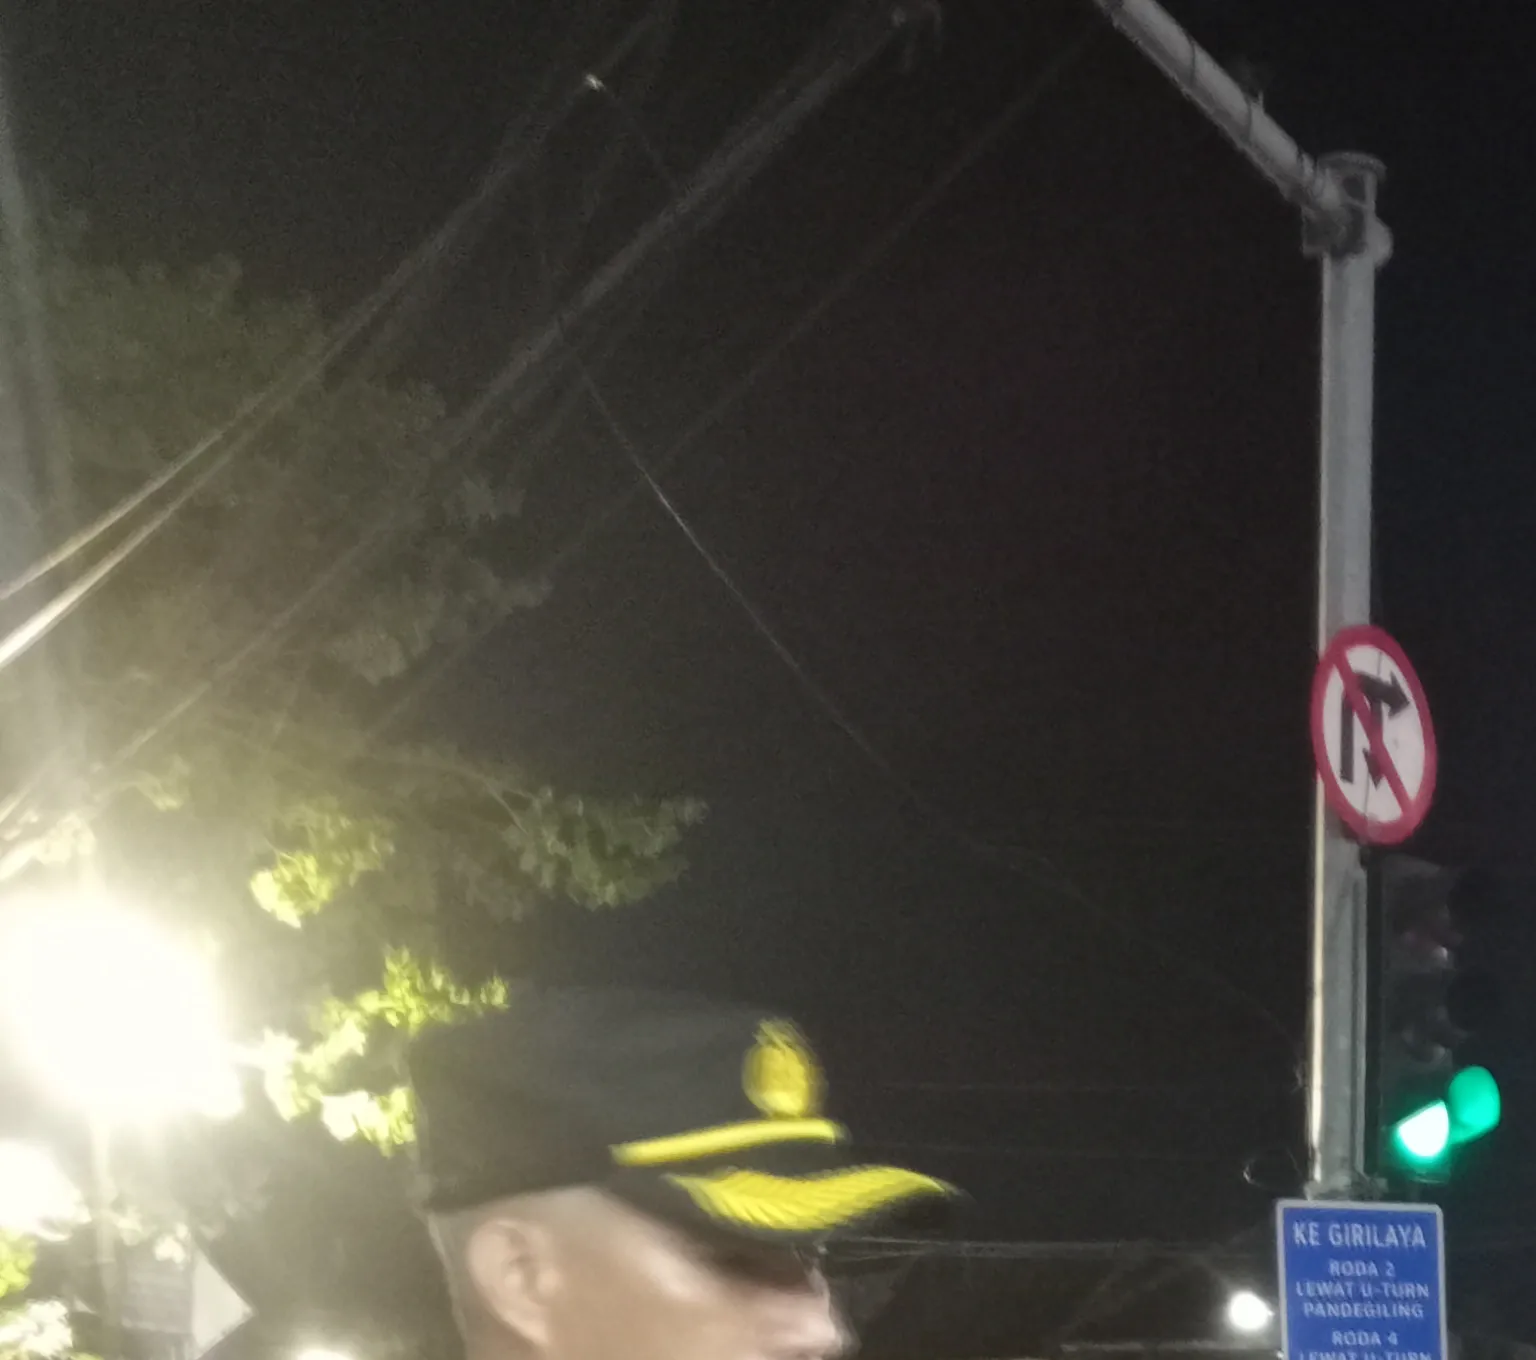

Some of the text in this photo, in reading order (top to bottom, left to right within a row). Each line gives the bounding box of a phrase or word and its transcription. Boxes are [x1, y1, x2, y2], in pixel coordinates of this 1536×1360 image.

[1292, 1221, 1427, 1248] KE GIRILAYA
[1329, 1260, 1396, 1277] RODA 2
[1296, 1281, 1430, 1298] LEWAT U-TURN
[1303, 1302, 1424, 1318] PANDEGILING
[1331, 1331, 1398, 1346] RODA 4
